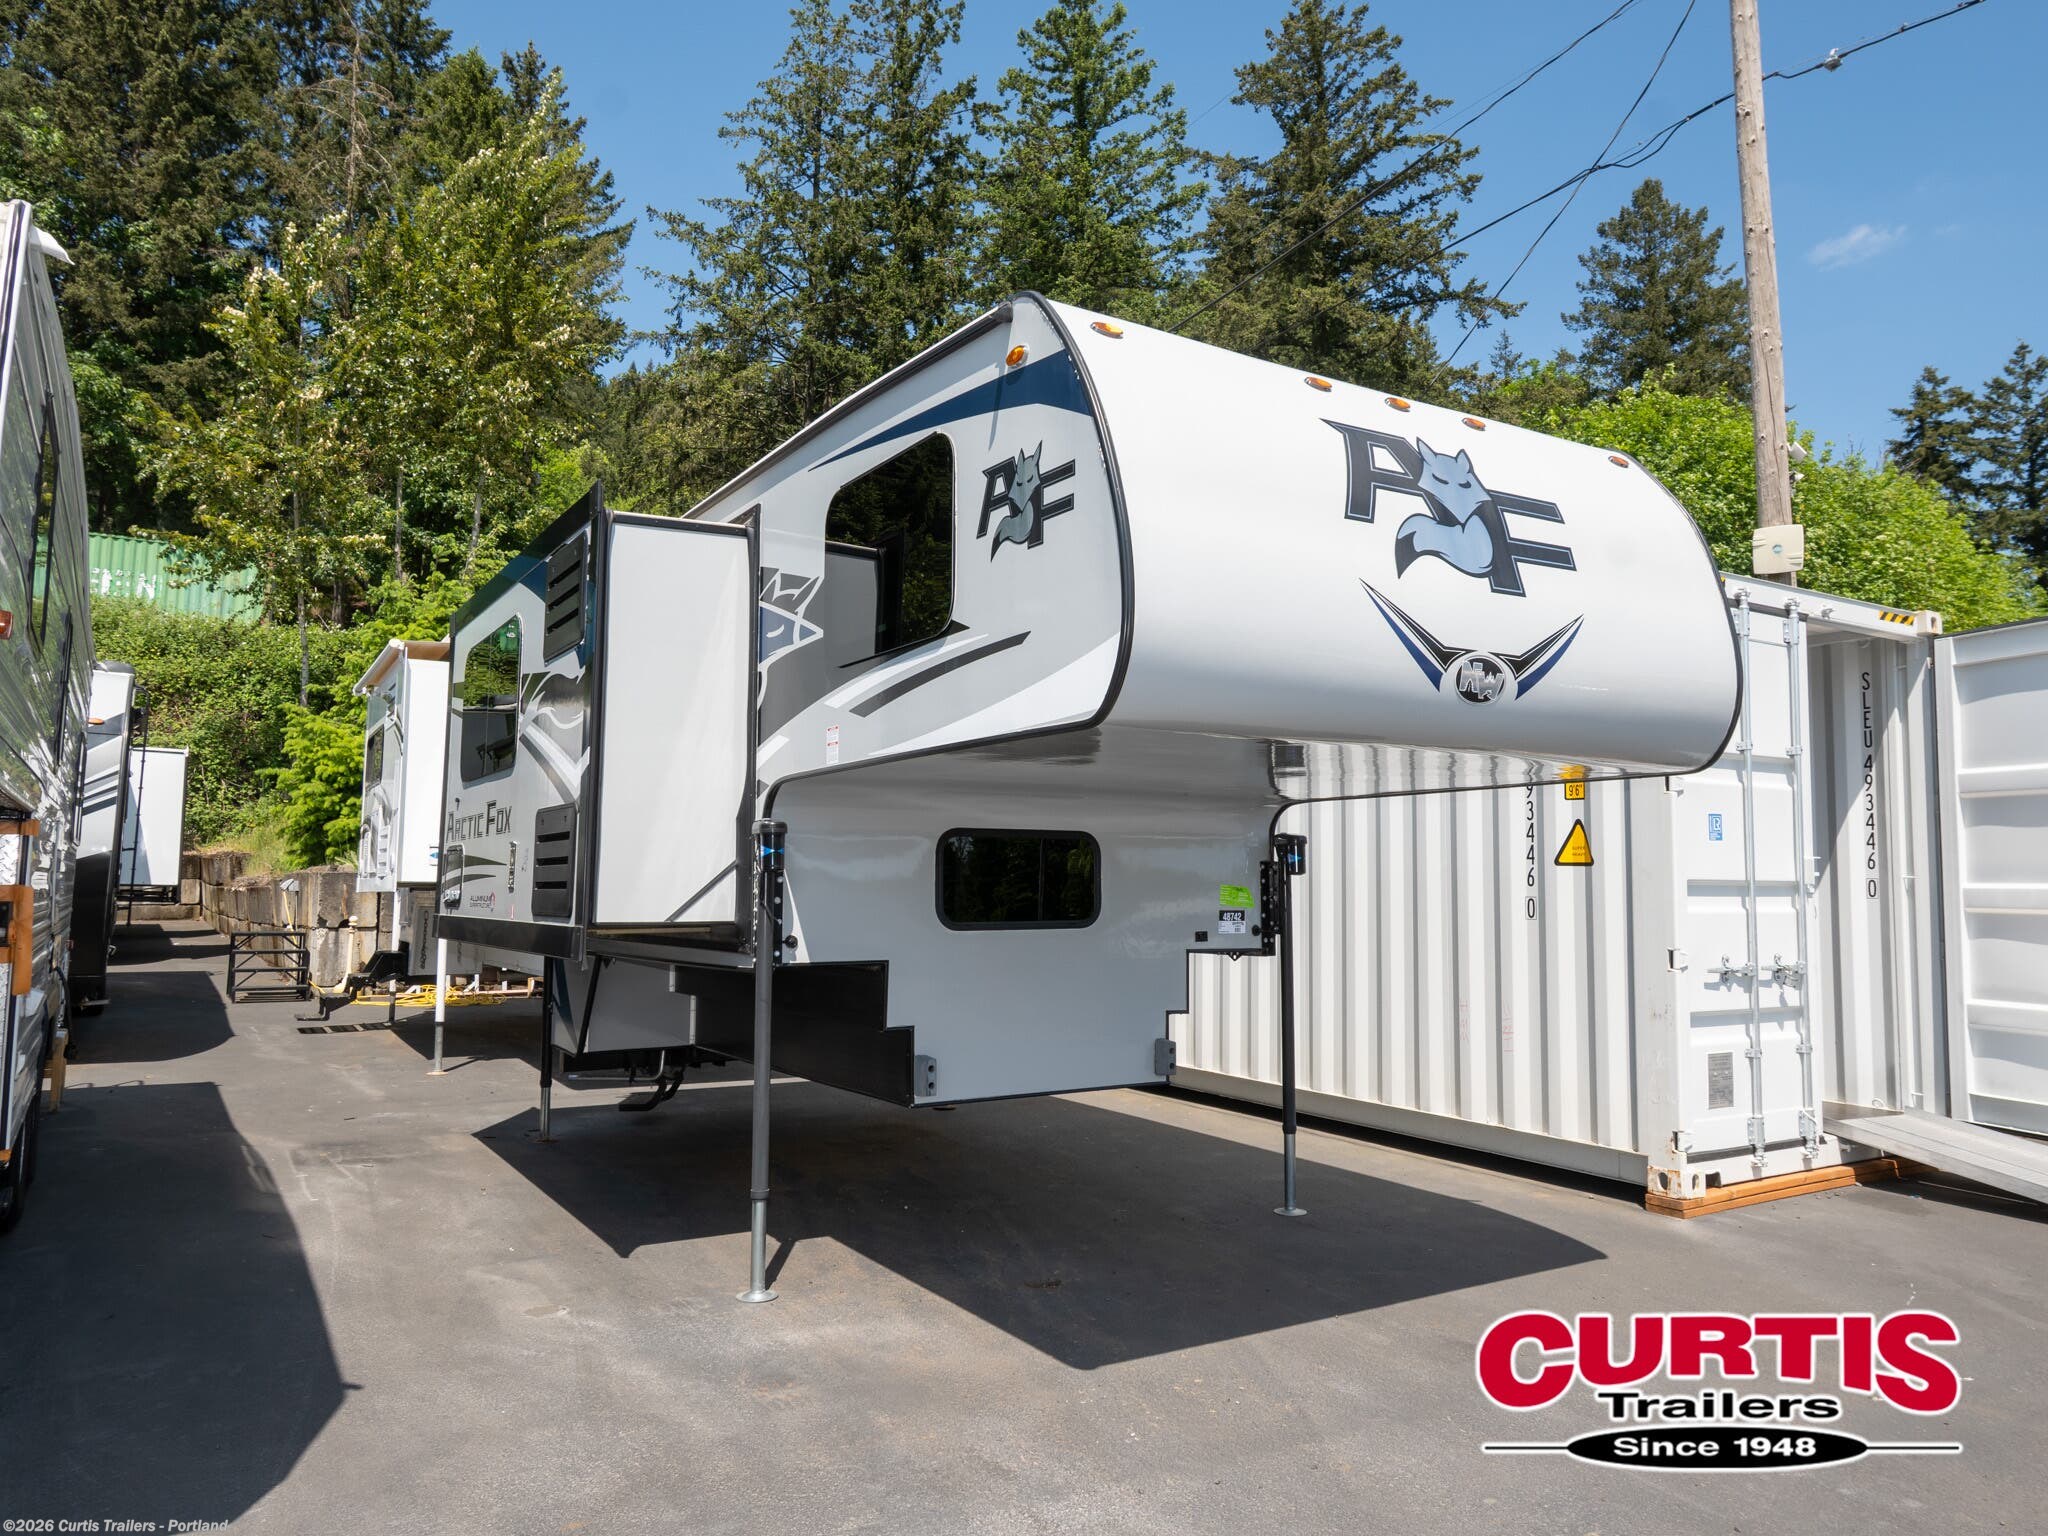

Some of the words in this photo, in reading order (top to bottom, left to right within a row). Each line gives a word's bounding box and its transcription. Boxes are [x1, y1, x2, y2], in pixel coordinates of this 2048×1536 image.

[1861, 671, 1873, 748] SLEU
[1864, 754, 1876, 870] 493446
[1868, 879, 1877, 898] 0
[1222, 912, 1242, 921] 48742
[1527, 898, 1535, 918] 0
